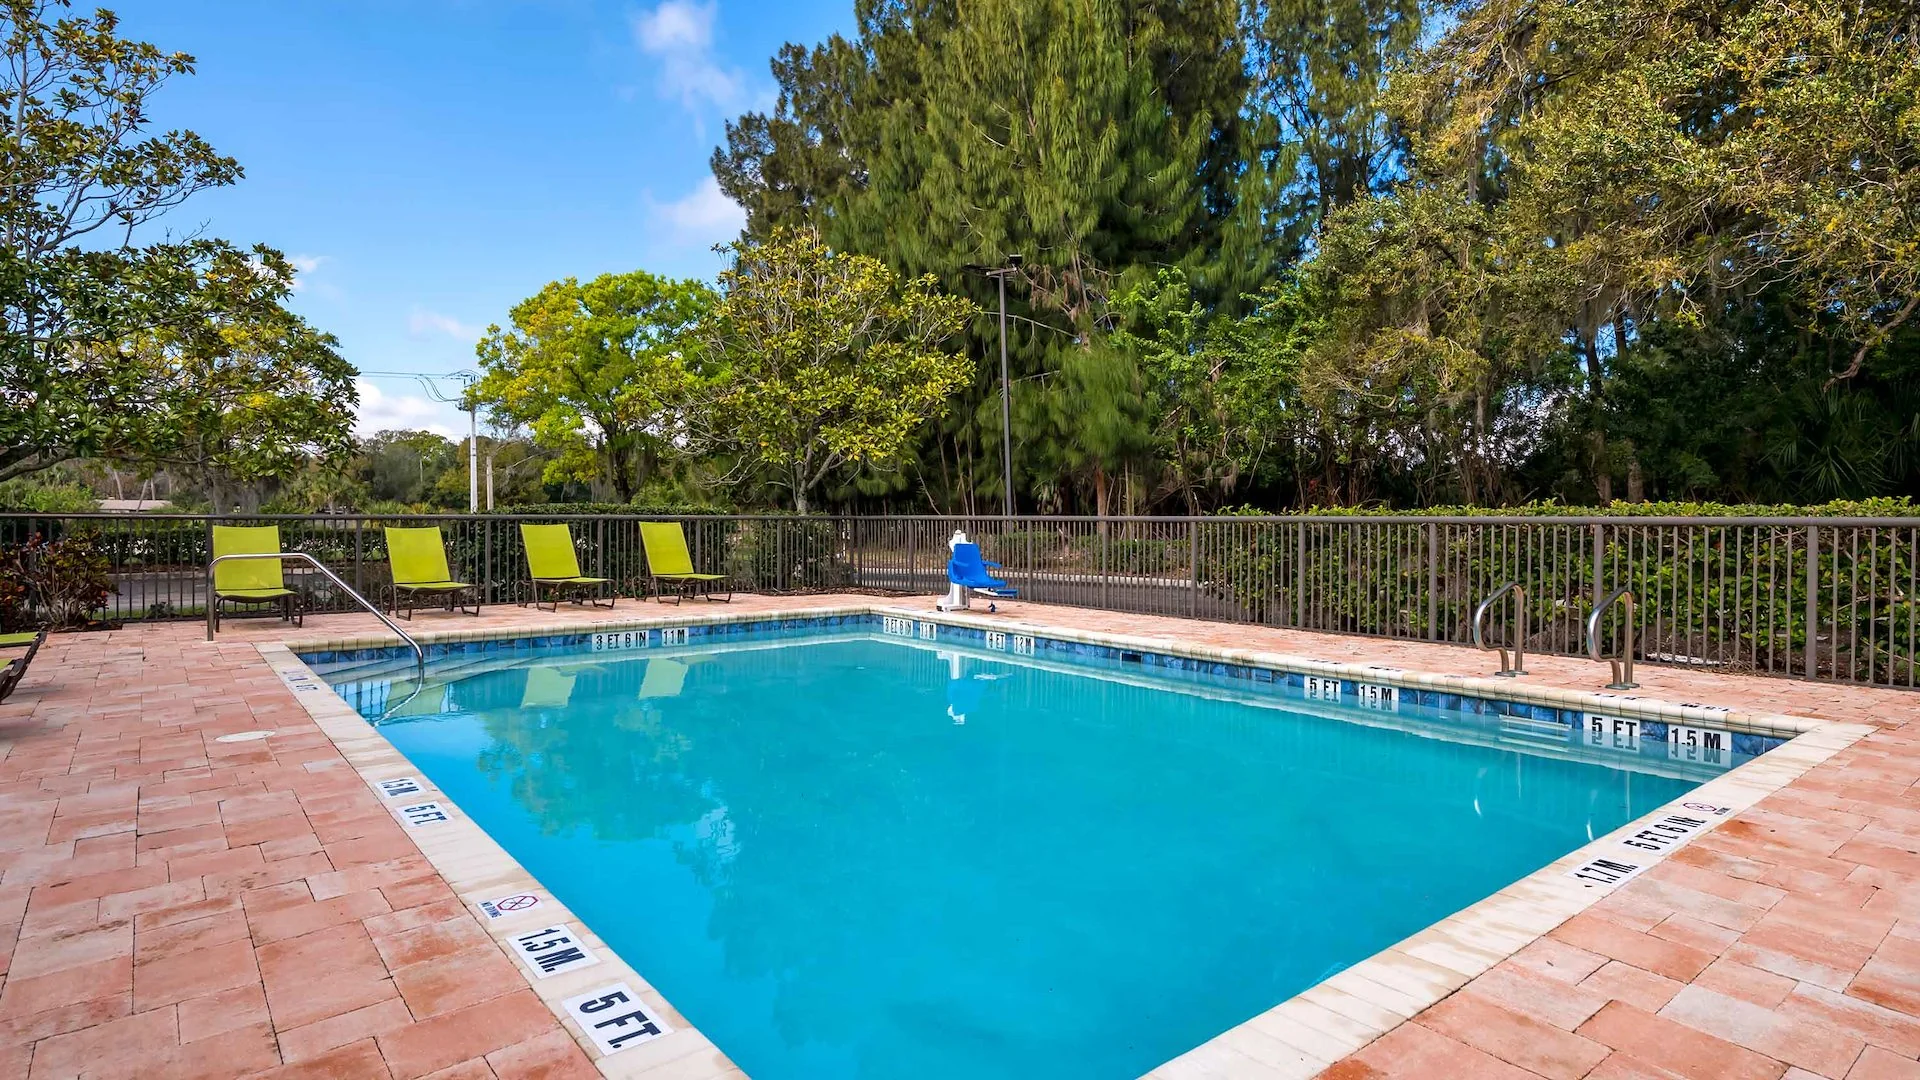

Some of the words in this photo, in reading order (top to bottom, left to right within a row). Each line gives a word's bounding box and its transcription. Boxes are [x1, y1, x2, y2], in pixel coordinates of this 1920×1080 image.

[1309, 677, 1317, 690] 5
[1323, 680, 1339, 693] FT
[1591, 716, 1603, 732] 5
[1613, 719, 1637, 736] FT
[518, 928, 571, 952] 1.5
[579, 990, 631, 1014] 5
[593, 1009, 662, 1049] FT.
